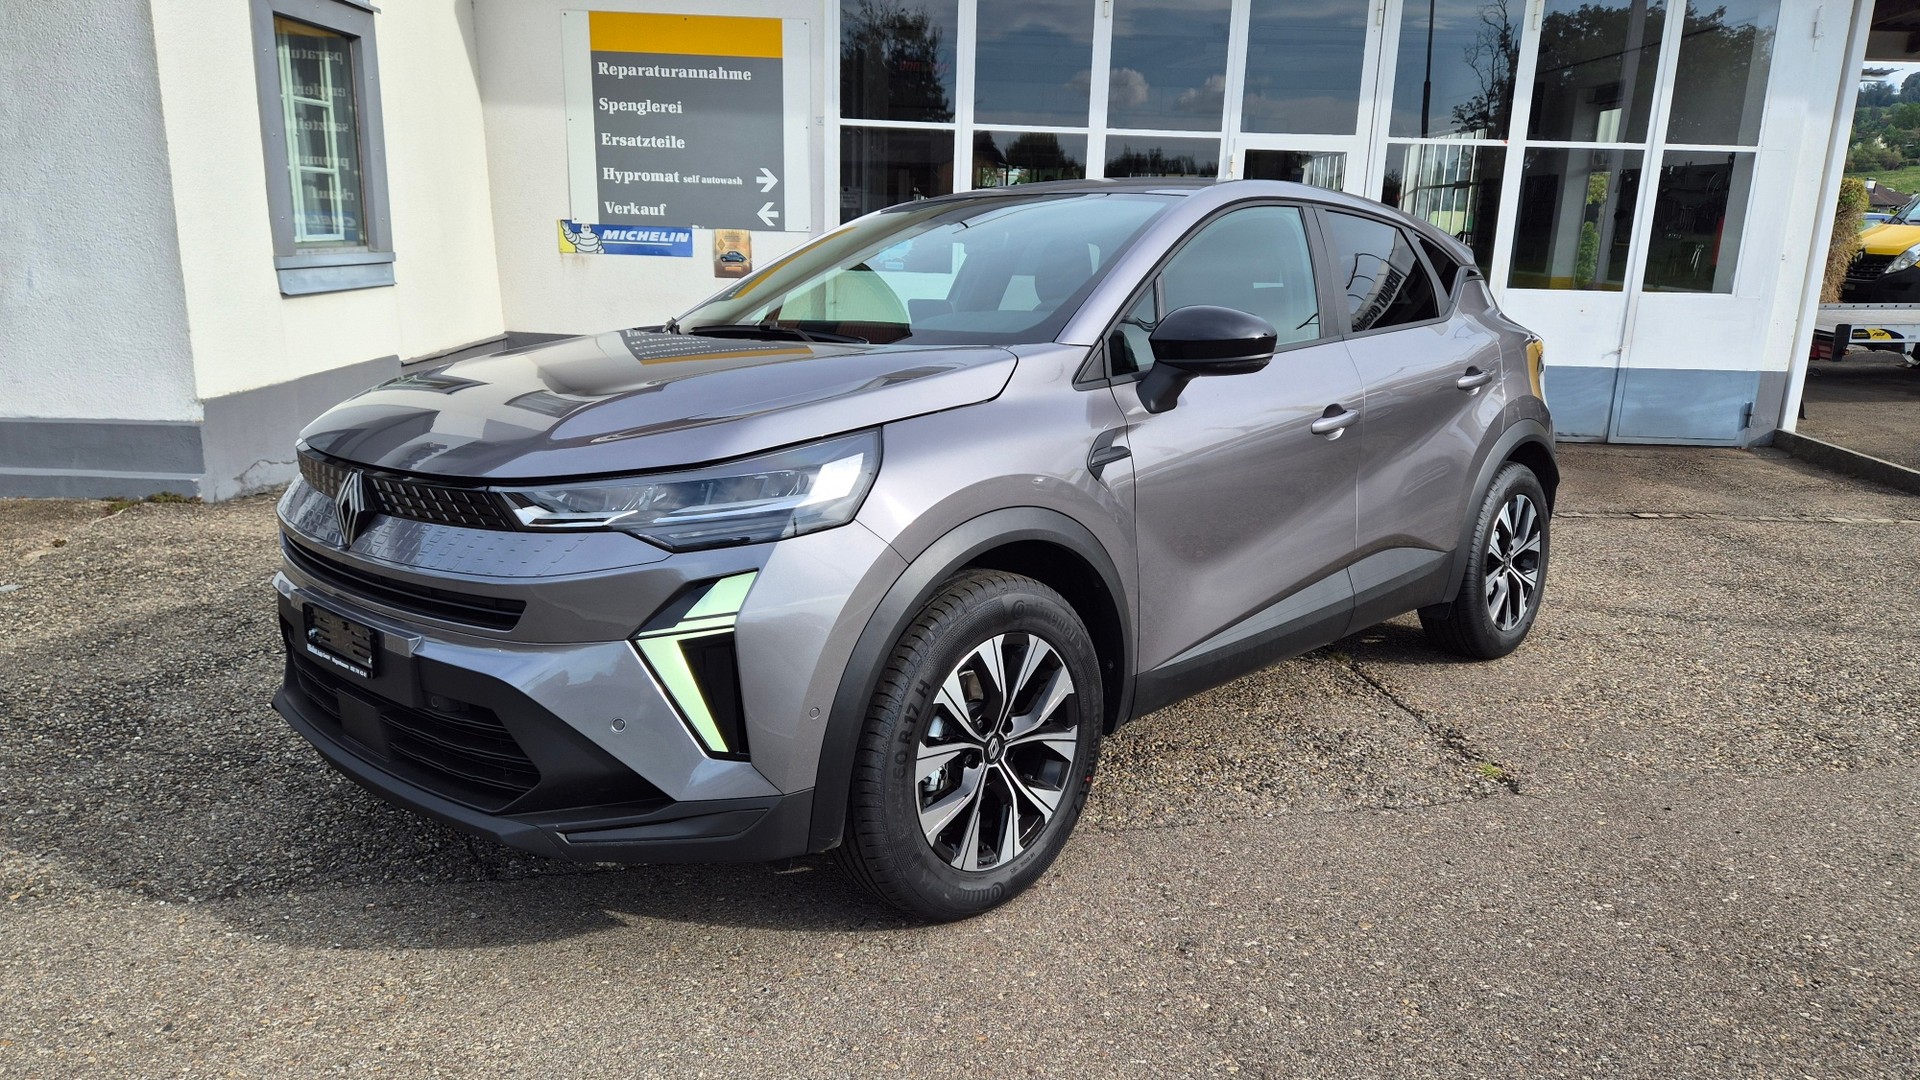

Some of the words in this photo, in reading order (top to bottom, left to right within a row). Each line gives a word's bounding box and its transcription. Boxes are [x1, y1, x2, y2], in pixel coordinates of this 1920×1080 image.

[597, 61, 752, 81] Reparaturannahme
[598, 97, 683, 116] Spenglerei
[600, 132, 686, 149] Ersatzteile
[602, 167, 680, 184] Hypromat
[682, 174, 701, 184] self
[701, 176, 743, 186] autowash
[604, 201, 667, 217] Verkauf
[601, 228, 690, 243] MICHELIN
